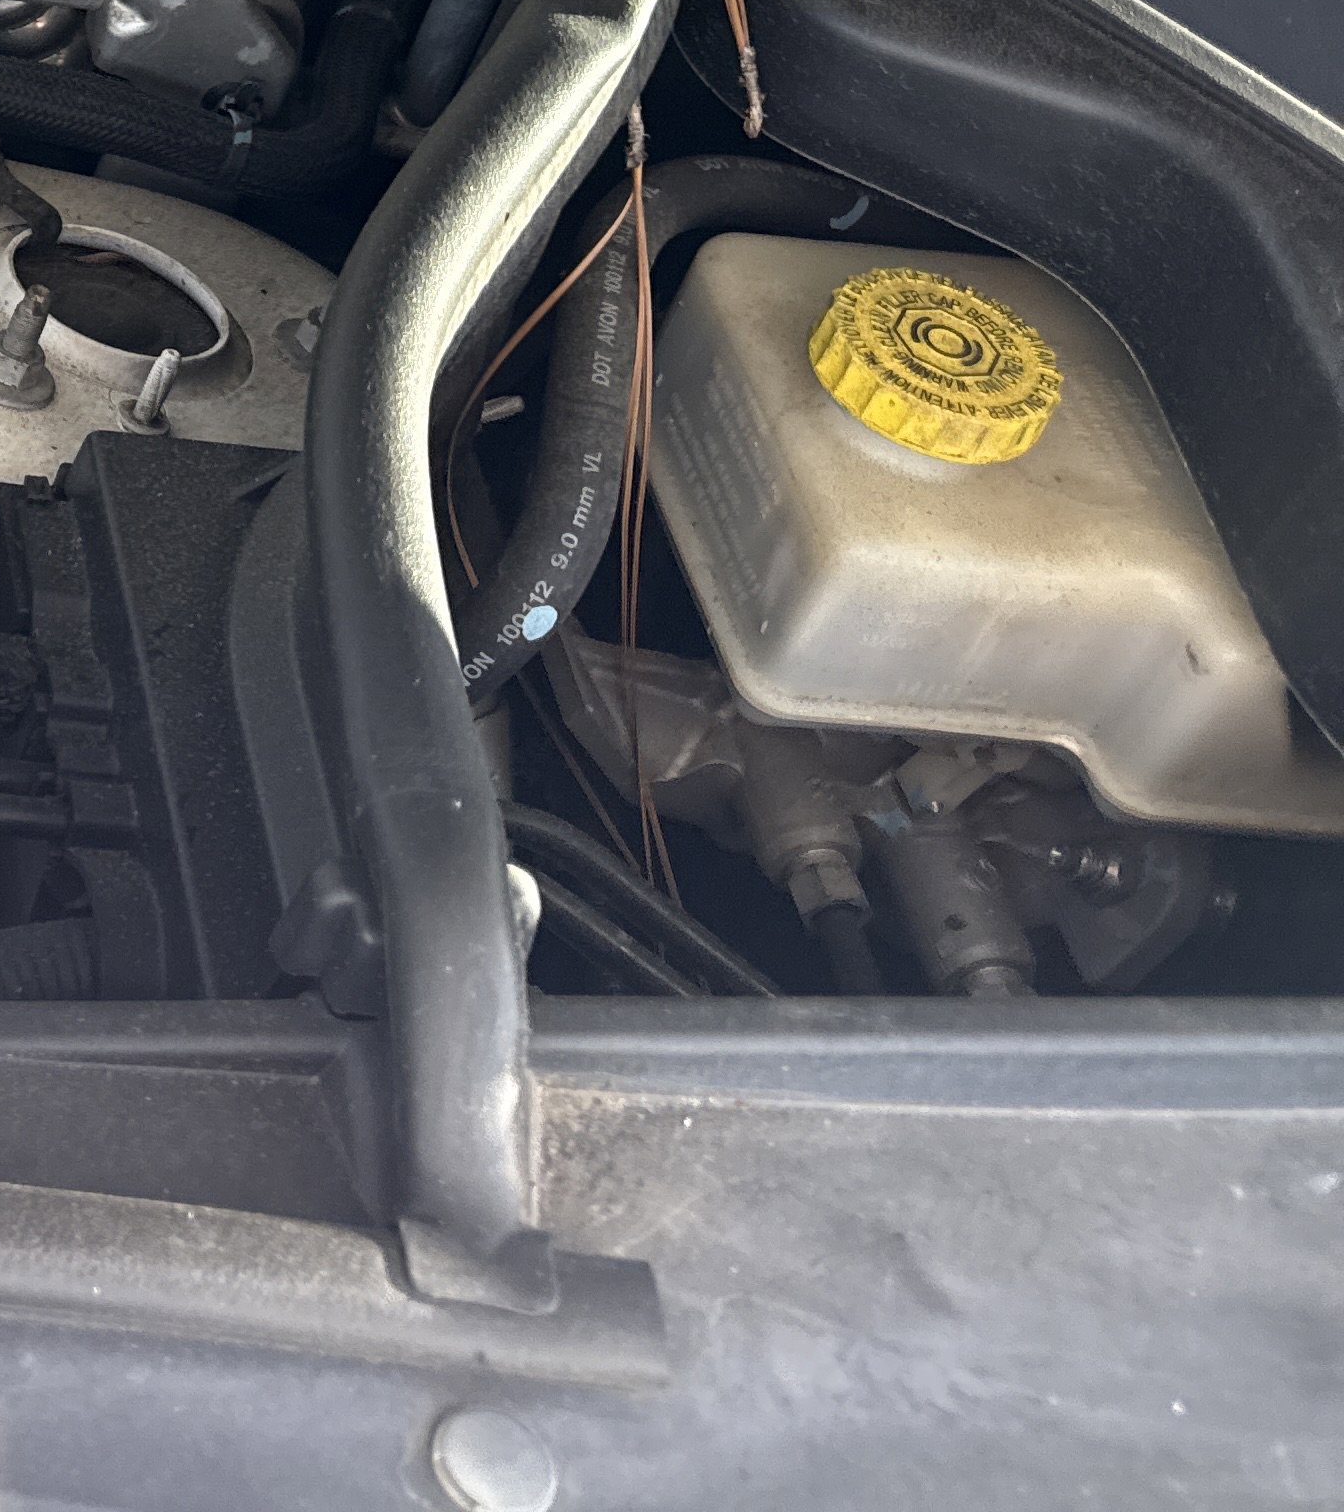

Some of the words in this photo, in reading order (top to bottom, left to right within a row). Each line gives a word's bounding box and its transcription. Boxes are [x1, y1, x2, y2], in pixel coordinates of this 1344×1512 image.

[603, 249, 627, 294] 100112
[874, 289, 925, 313] FILLER
[926, 291, 962, 311] CAP
[596, 300, 620, 348] AVON
[869, 308, 899, 348] CLEAN
[964, 307, 1021, 354] BEFORE
[590, 350, 613, 388] DOT
[880, 369, 976, 417] ATTENTION
[1028, 333, 1059, 373] AVANT
[892, 350, 970, 393] WARNING
[581, 450, 603, 474] VL
[571, 485, 597, 530] mm
[550, 531, 580, 570] 9.0
